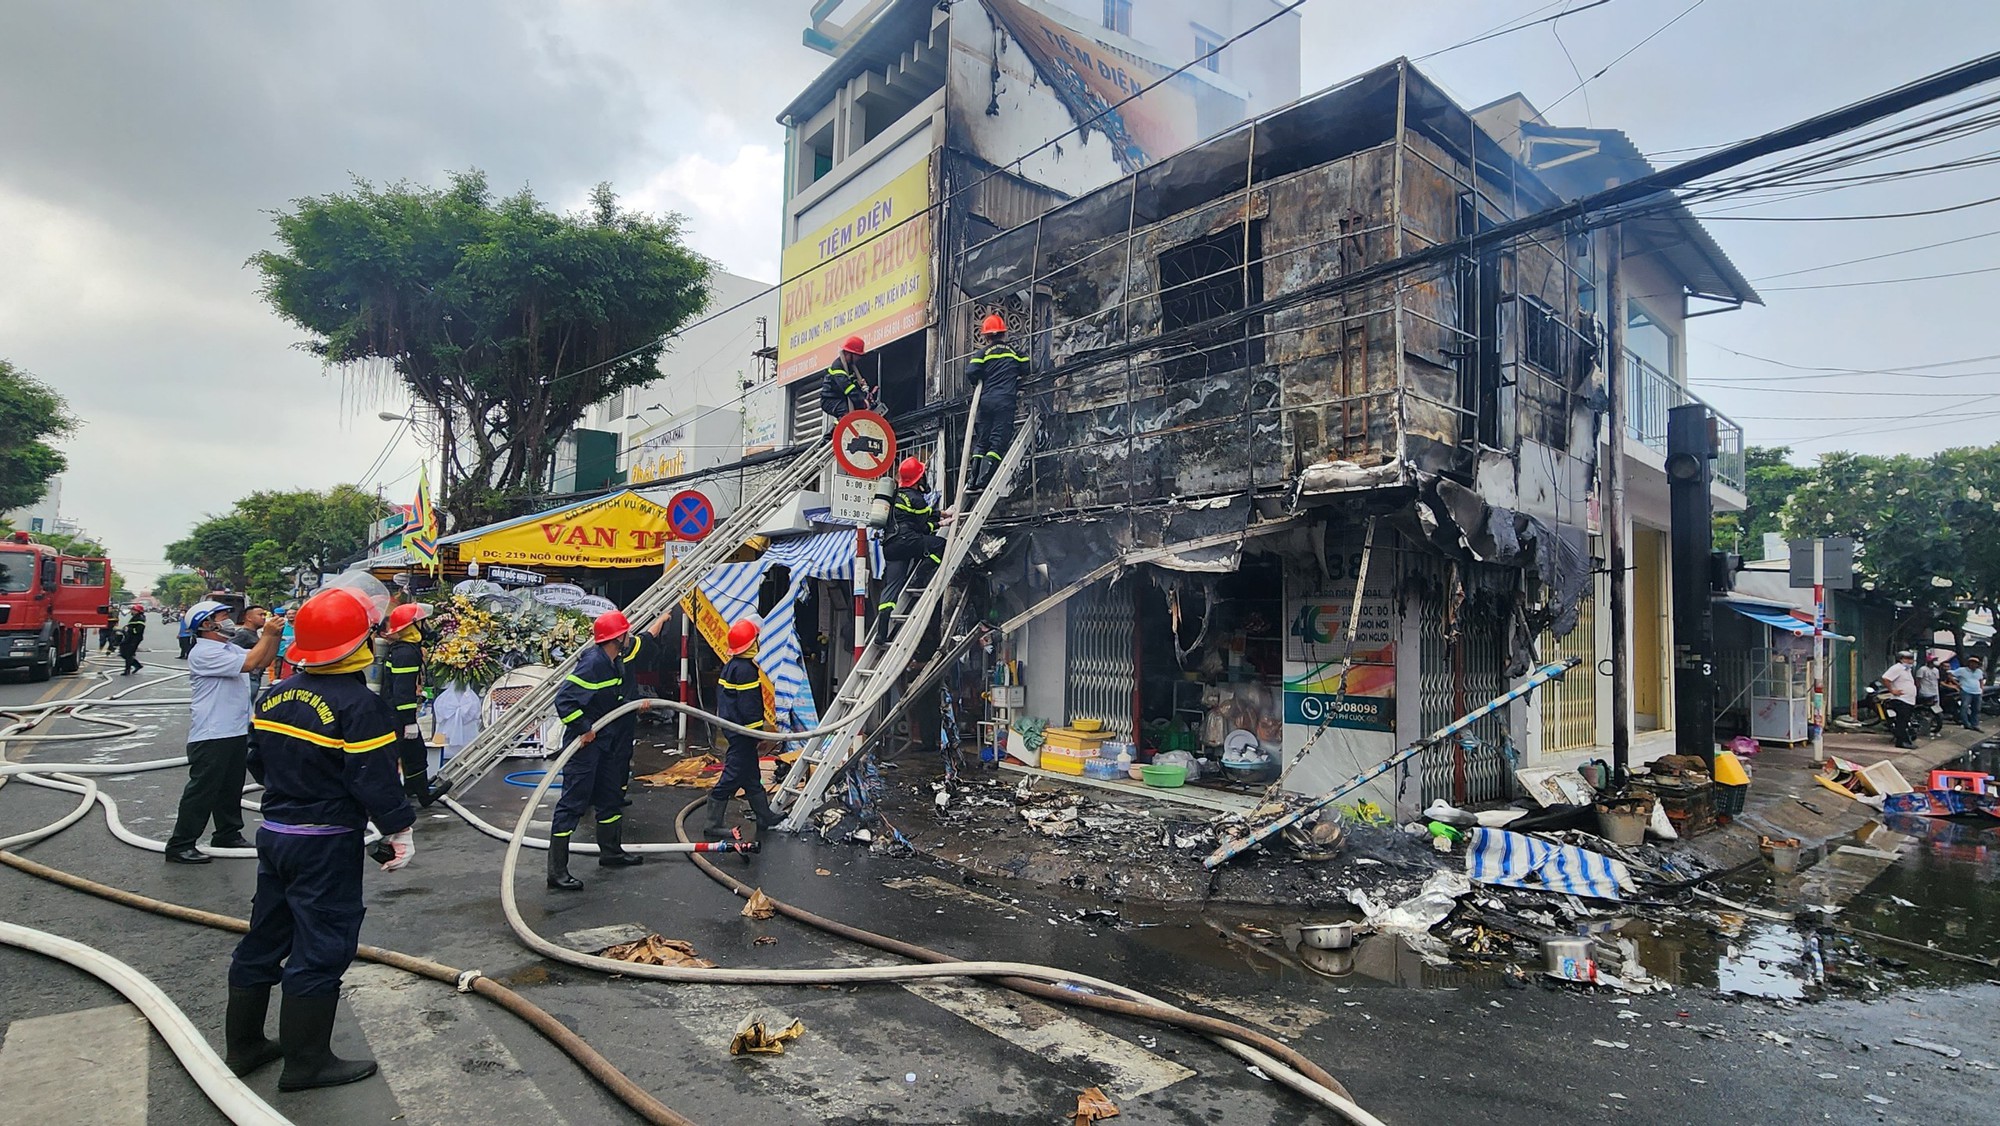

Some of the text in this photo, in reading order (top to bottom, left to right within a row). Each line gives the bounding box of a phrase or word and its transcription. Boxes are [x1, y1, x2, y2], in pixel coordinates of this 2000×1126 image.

[1039, 25, 1143, 100] TIỆM ĐIỆN
[818, 197, 892, 259] TIỆM ĐIỆN
[847, 308, 853, 323] XE
[624, 500, 636, 510] VỤ
[540, 524, 678, 550] VẠN TH
[483, 550, 502, 558] ĐC:
[506, 551, 526, 559] 219
[530, 550, 551, 560] NGÔ
[1291, 605, 1339, 643] 4G
[1703, 664, 1711, 675] 3
[283, 688, 296, 702] SÁT
